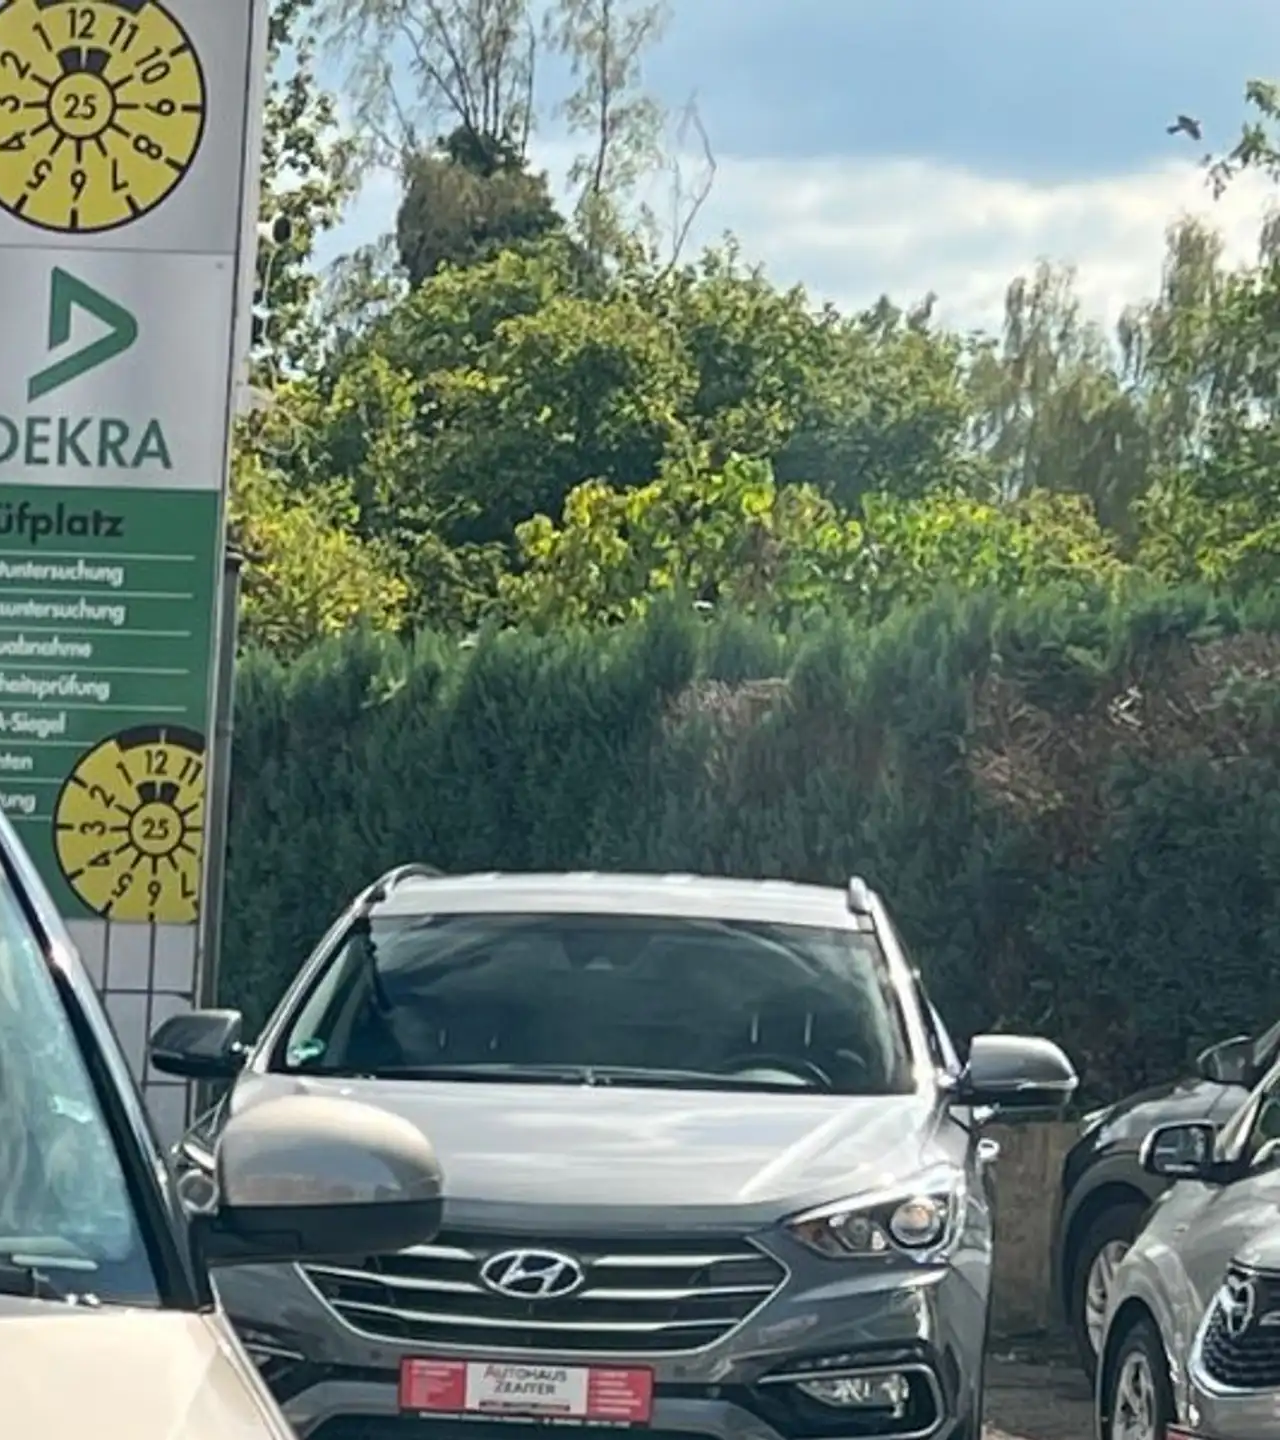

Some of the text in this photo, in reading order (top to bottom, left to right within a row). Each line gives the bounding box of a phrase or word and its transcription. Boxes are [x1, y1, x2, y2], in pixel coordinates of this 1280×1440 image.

[67, 7, 96, 39] 12
[109, 15, 138, 52] 11
[32, 22, 53, 51] 1
[0, 51, 31, 80] 2
[135, 46, 170, 85] 10
[63, 94, 96, 120] 25
[145, 99, 176, 116] 9
[132, 134, 163, 160] 8
[26, 159, 53, 190] 5
[70, 169, 86, 202] 6
[111, 158, 128, 192] 7
[116, 761, 133, 786] 1
[145, 750, 168, 775] 12
[179, 756, 203, 786] 11
[90, 785, 116, 808] 2
[80, 821, 106, 836] 3
[141, 819, 169, 840] 25
[88, 851, 111, 867] 4
[112, 873, 133, 897] 5
[148, 881, 161, 907] 6
[181, 872, 195, 898] 7
